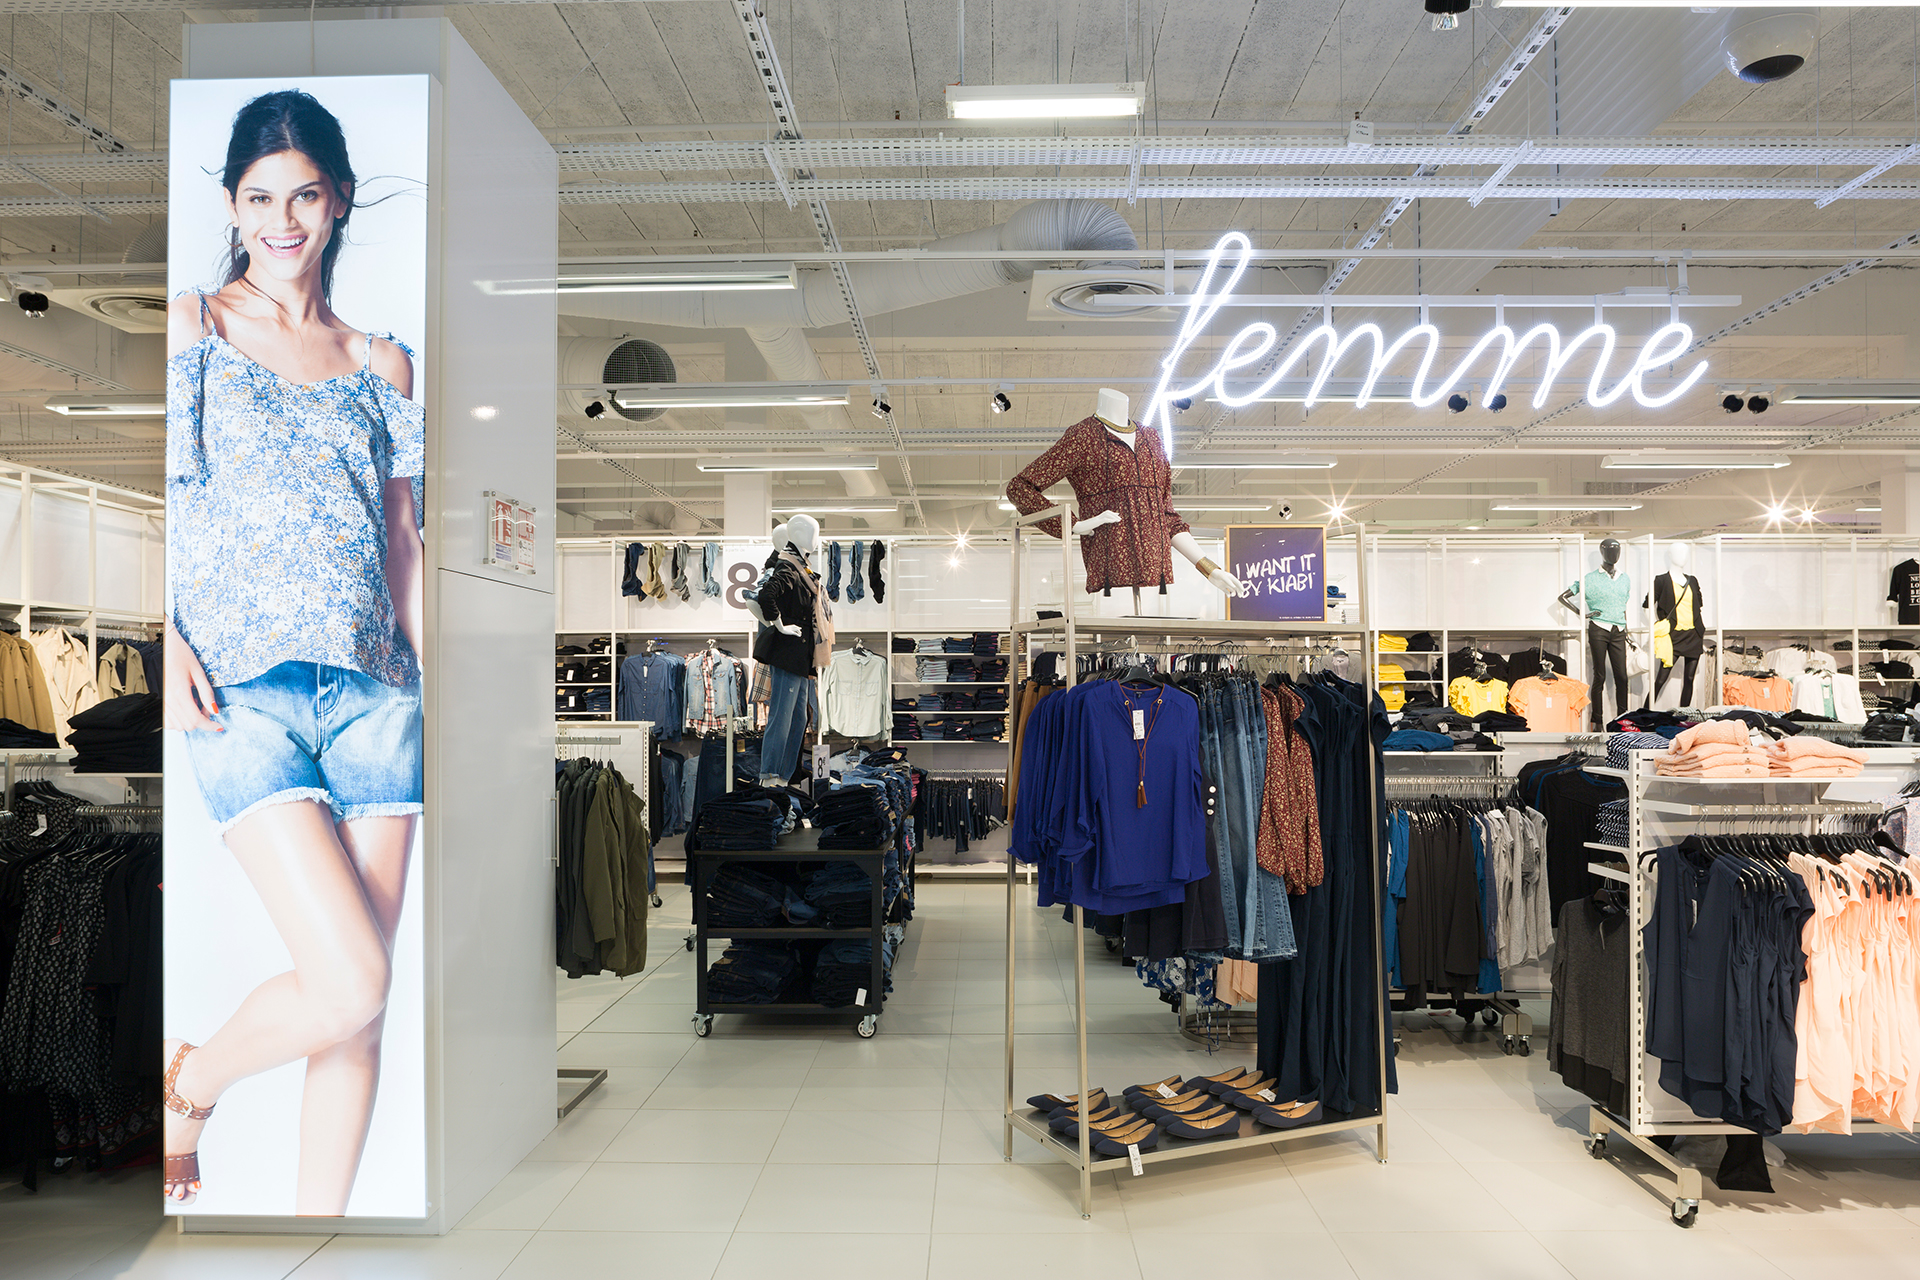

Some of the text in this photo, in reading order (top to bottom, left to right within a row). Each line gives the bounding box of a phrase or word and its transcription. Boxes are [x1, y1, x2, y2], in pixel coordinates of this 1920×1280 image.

[1142, 231, 1709, 463] femme
[1235, 553, 1316, 581] I WANT IT
[1239, 573, 1313, 598] BY KIABI
